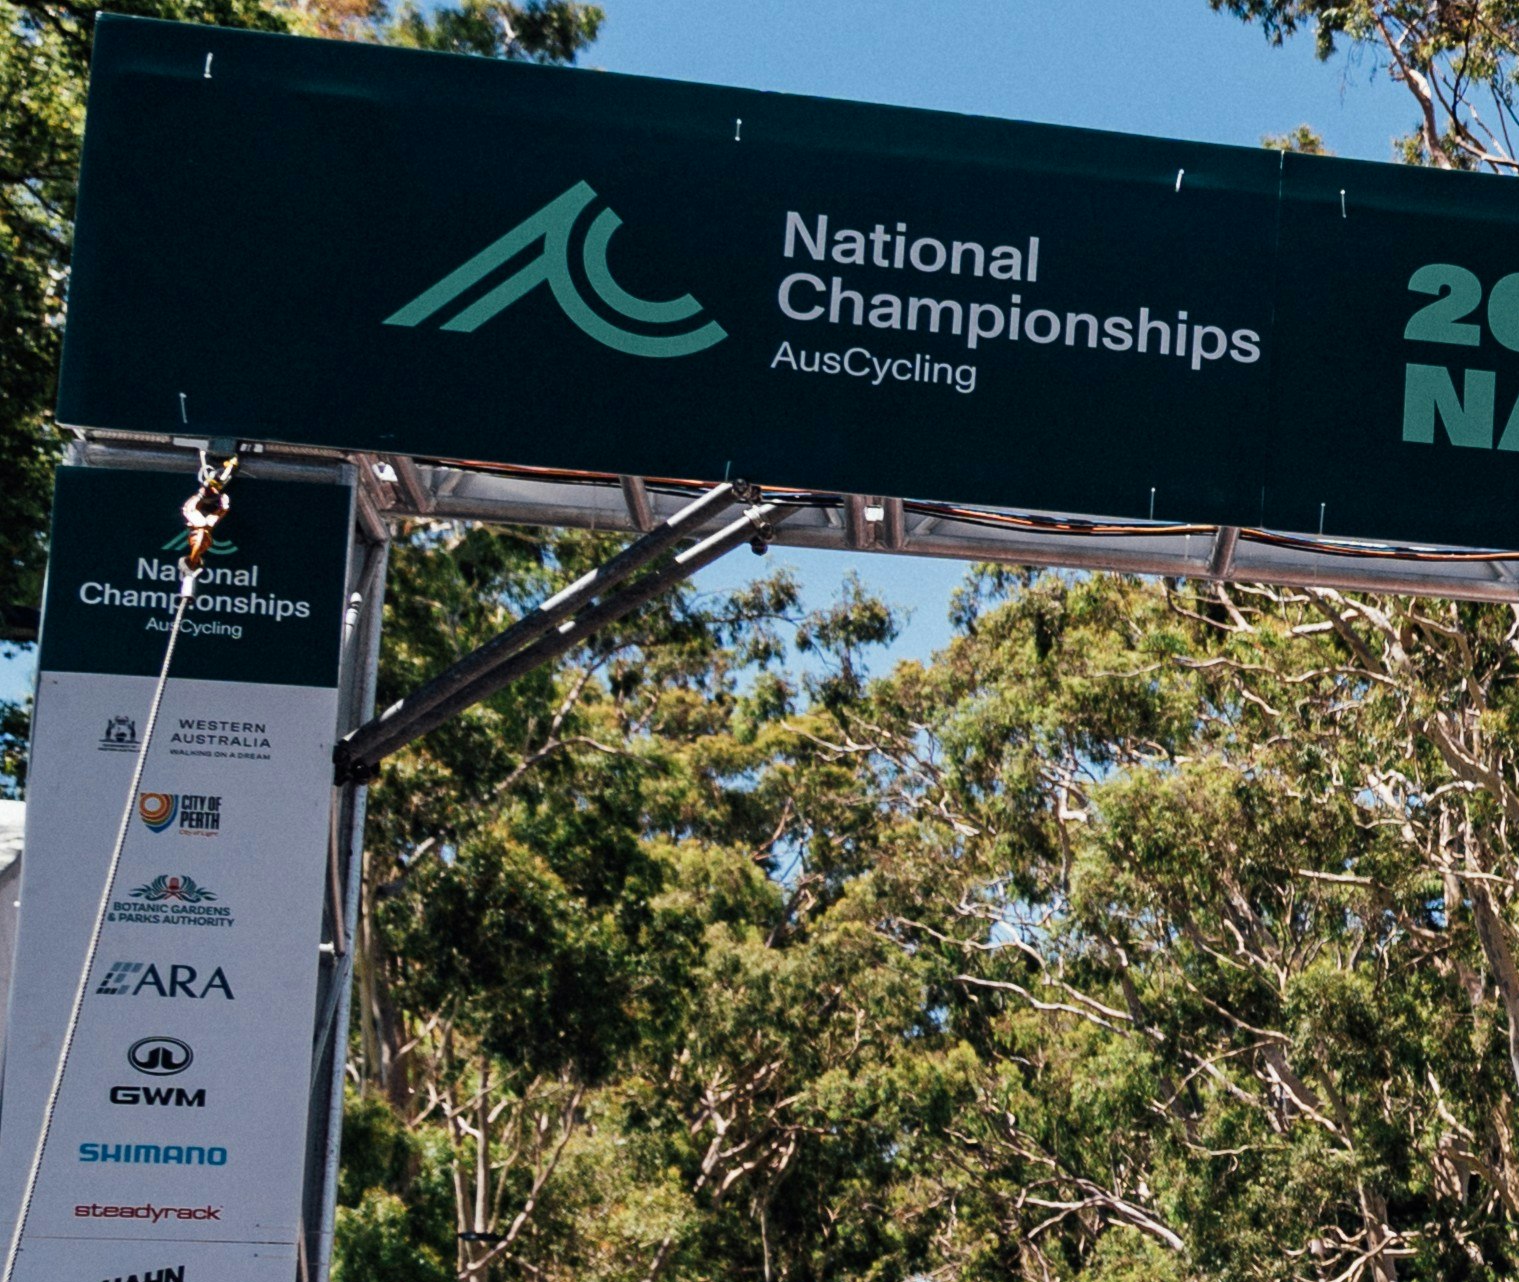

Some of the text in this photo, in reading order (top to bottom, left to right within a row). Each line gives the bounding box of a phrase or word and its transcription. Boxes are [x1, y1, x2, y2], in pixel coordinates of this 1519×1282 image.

[783, 210, 1040, 282] National
[776, 271, 1263, 371] Championships
[769, 341, 978, 393] AusCycling
[137, 557, 258, 586] Naonal
[79, 581, 310, 619] Champonships
[145, 617, 243, 638] AusCycling
[179, 719, 266, 733] WESTERN
[171, 733, 271, 748] AUSTRALIA
[169, 749, 212, 758] WALKING
[182, 795, 222, 810] CITY OF
[180, 811, 220, 830] PERTH
[107, 913, 235, 927] & PARKS AUTHORITY
[113, 902, 231, 917] BOTANIC GARDENS
[134, 963, 235, 1000] ARA
[110, 1085, 206, 1107] GWM
[79, 1143, 227, 1166] SHIMANO
[74, 1203, 220, 1223] steadyrack
